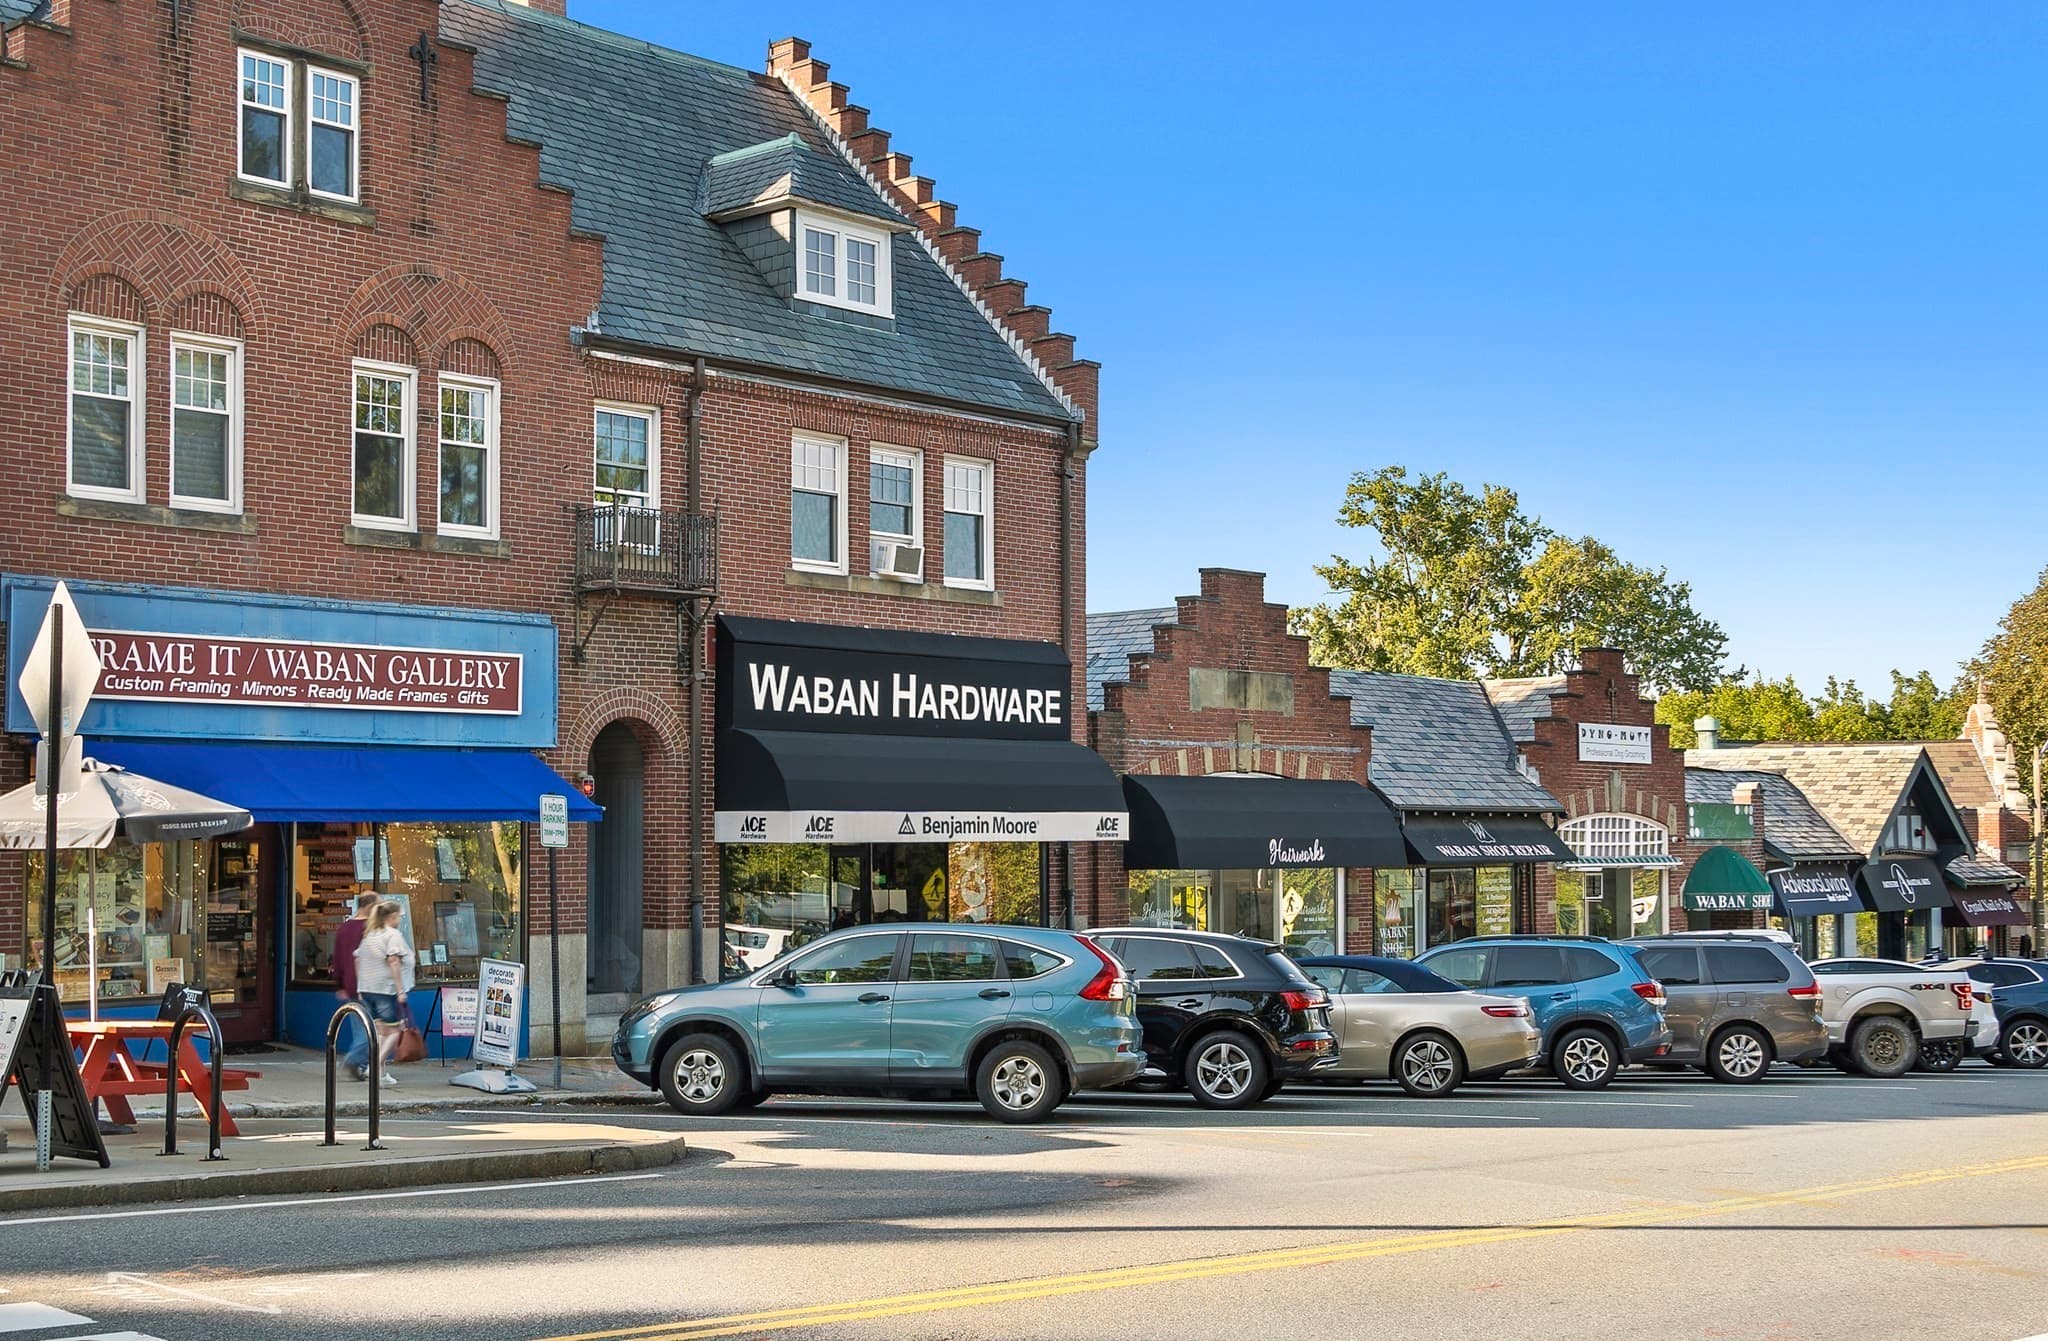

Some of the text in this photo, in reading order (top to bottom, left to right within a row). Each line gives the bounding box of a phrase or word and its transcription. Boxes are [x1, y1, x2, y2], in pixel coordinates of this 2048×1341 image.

[208, 645, 241, 676] IT
[265, 648, 377, 684] WABAN
[387, 654, 511, 690] GALLERY
[104, 674, 490, 705] Custom Framing Mirrors Ready Made Frames Gifts
[749, 663, 1062, 725] WABAN HARDWARE
[548, 802, 563, 813] HOUR
[543, 813, 564, 824] PARKING
[740, 815, 767, 831] ACE
[805, 815, 834, 831] ACE
[1096, 815, 1119, 831] ACE
[922, 815, 1037, 839] Benjamin Moore
[740, 832, 767, 840] Hardware
[805, 832, 834, 840] Hardware
[1269, 837, 1326, 865] Hairworks
[1435, 844, 1555, 857] WABAN SHOE REPAIR
[1779, 871, 1852, 898] AdvisorsLiving
[1696, 895, 1746, 908] WABAN
[1380, 928, 1408, 938] WABAN
[1382, 943, 1404, 954] SHOE
[489, 967, 515, 979] decorate
